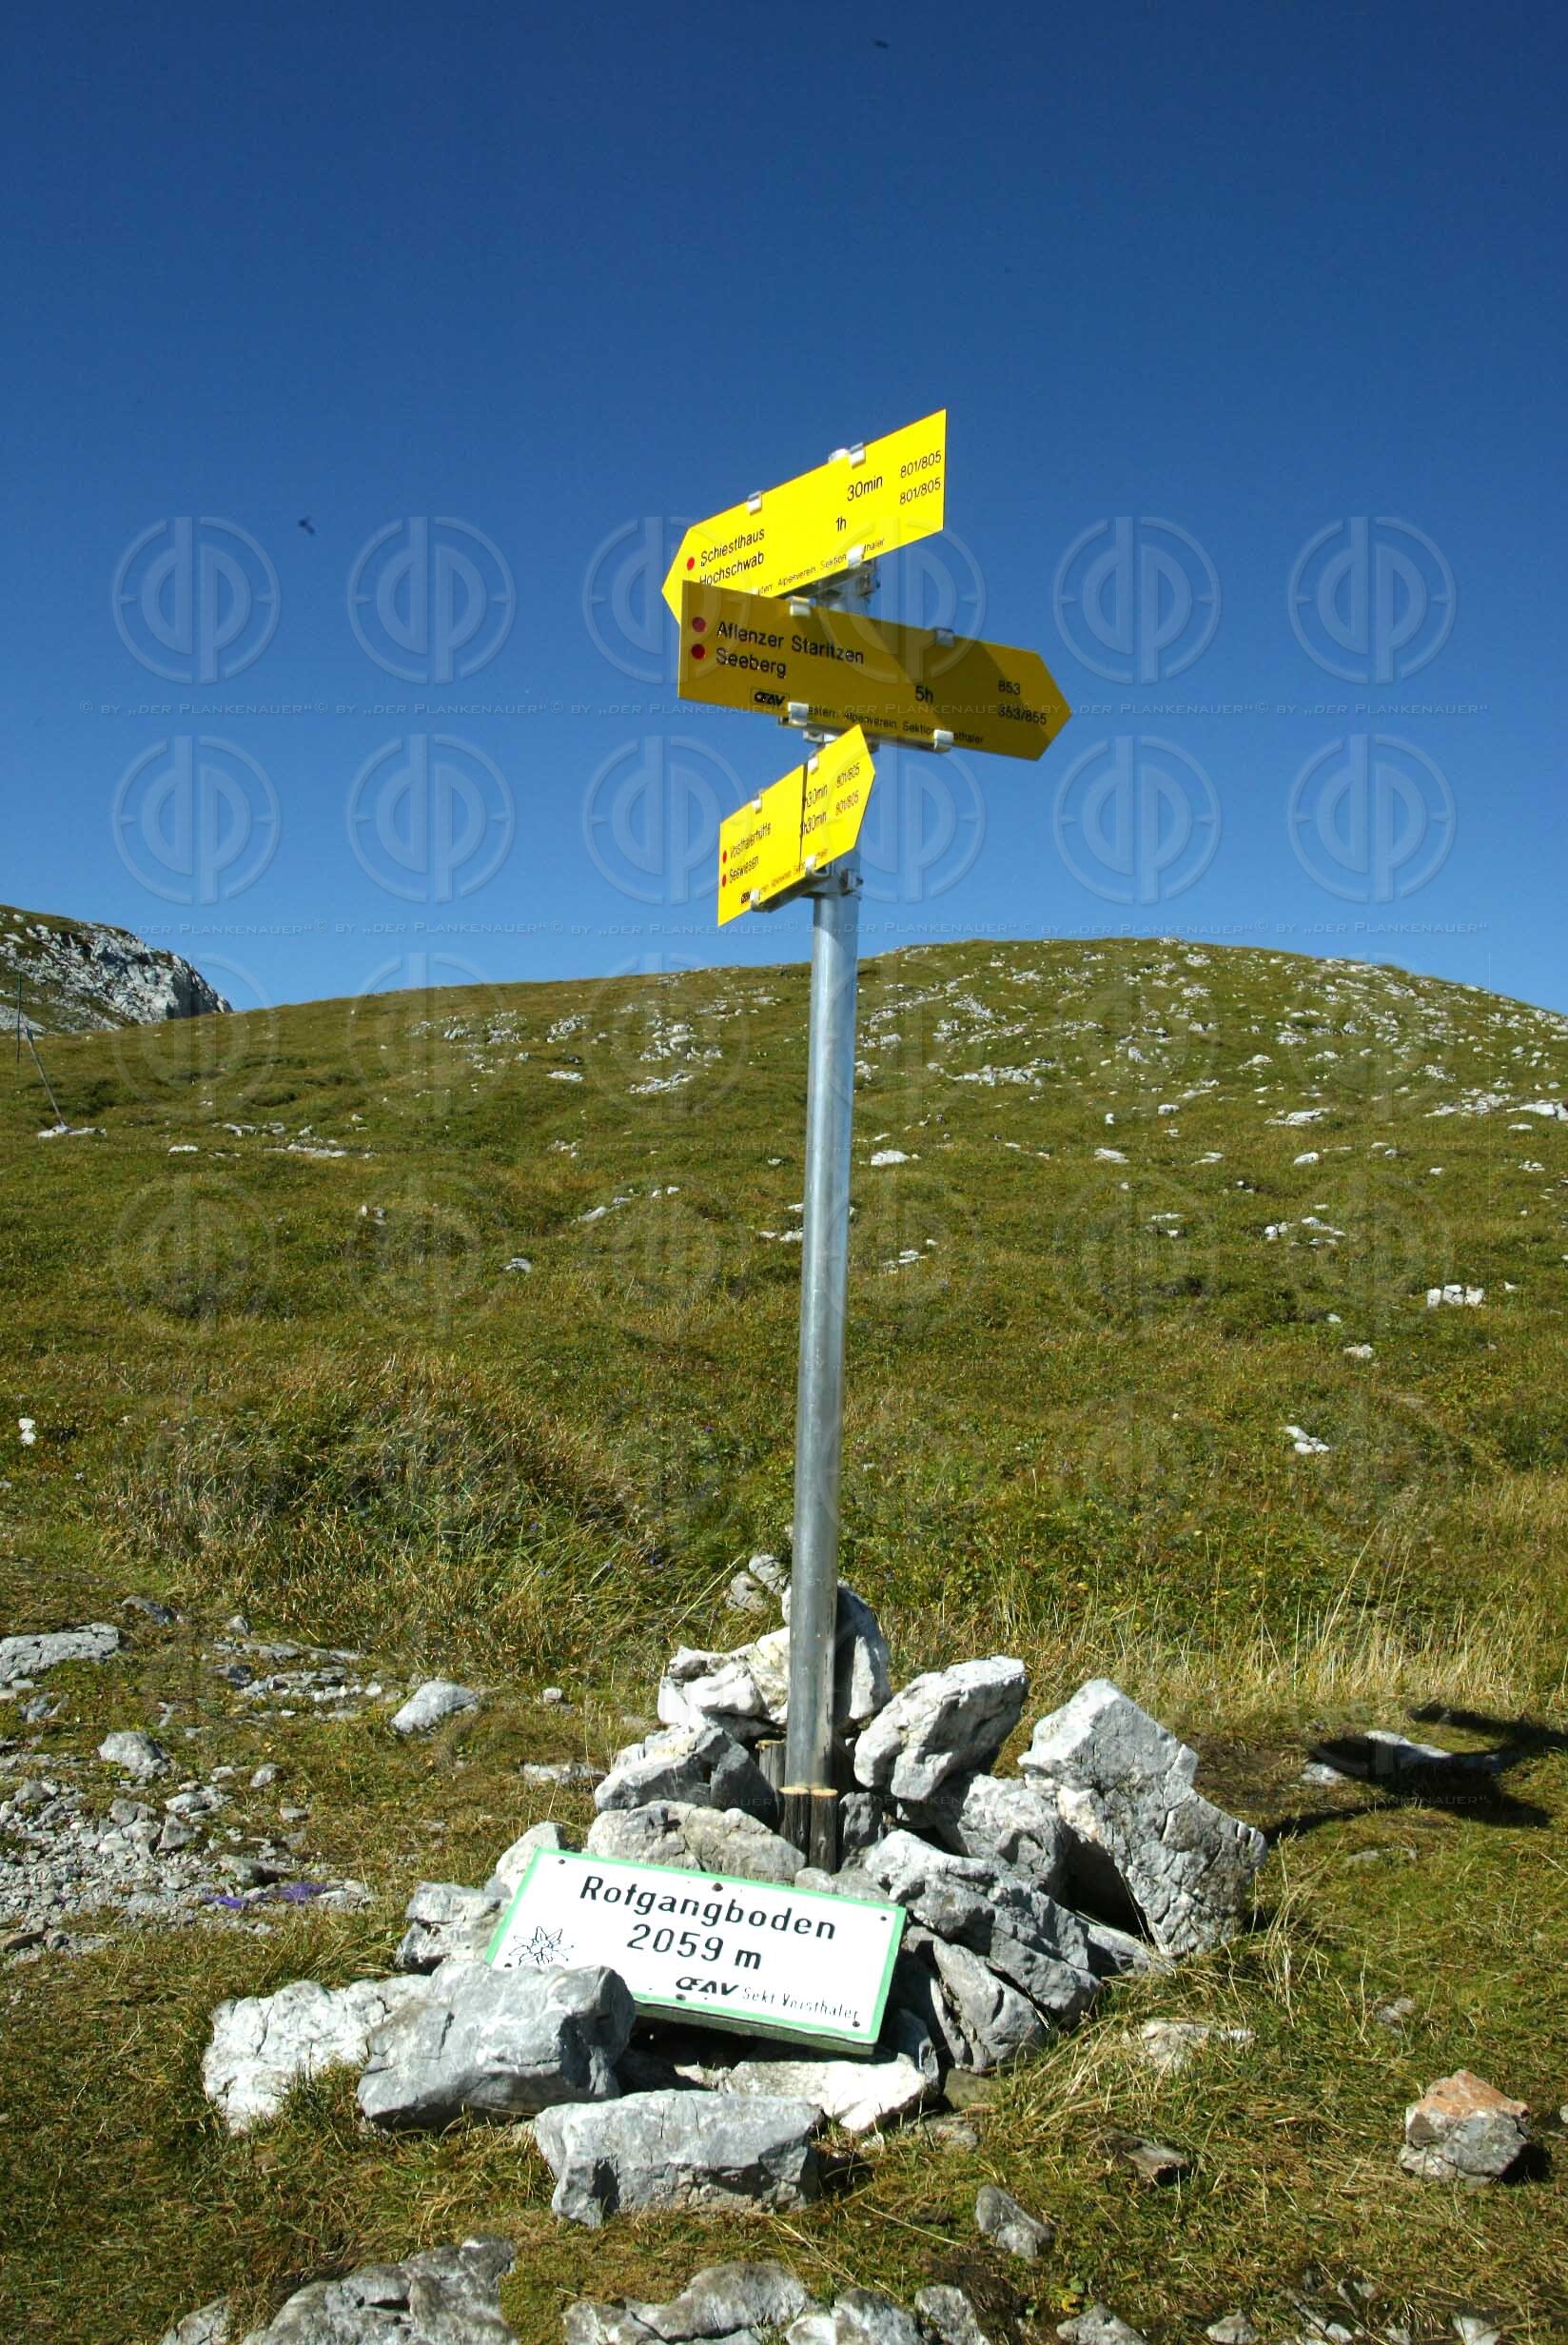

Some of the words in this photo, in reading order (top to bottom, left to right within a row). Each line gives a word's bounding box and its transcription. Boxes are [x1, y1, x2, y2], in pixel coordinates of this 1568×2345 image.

[699, 551, 765, 585] Hochschwab
[835, 516, 847, 532] 1h
[899, 477, 941, 504] 801/805
[700, 528, 765, 564] Schiestlhaus
[847, 476, 883, 502] 30min
[900, 449, 941, 478] 801/805
[715, 647, 787, 679] Seeberg
[915, 685, 933, 703] 5h
[716, 621, 784, 648] Aflenzer
[792, 635, 864, 664] Staritzen
[998, 680, 1021, 695] 853
[579, 1875, 836, 1940] Rotgangboden
[626, 1923, 725, 1962] 2059
[734, 1948, 762, 1971] m
